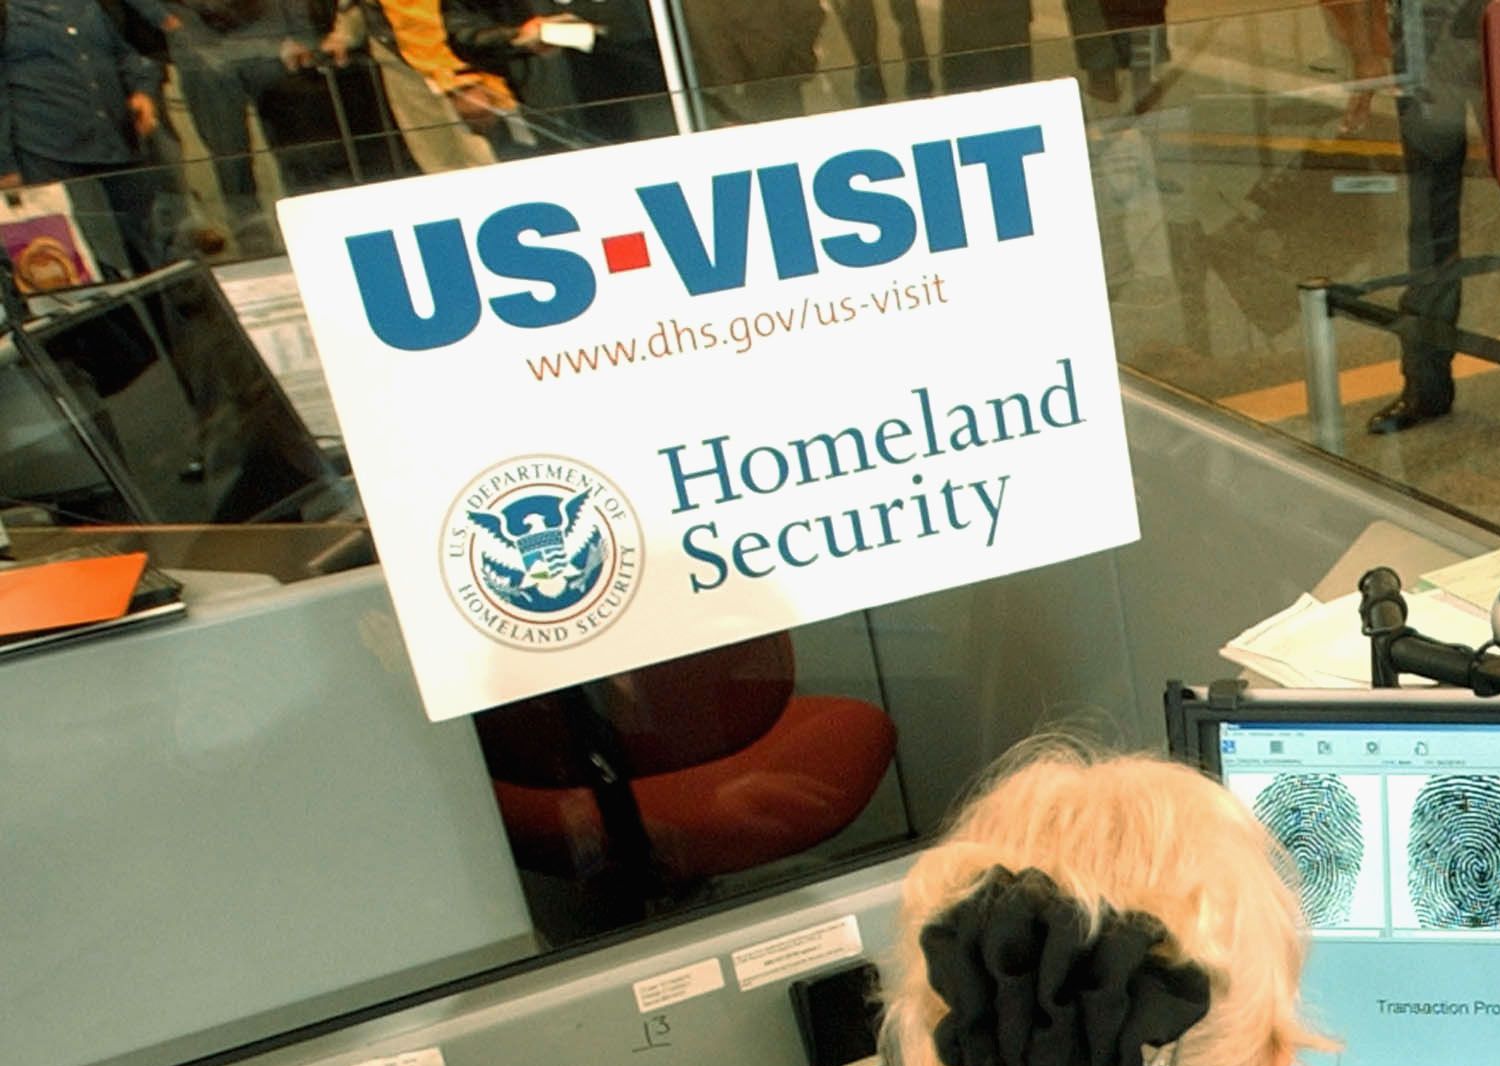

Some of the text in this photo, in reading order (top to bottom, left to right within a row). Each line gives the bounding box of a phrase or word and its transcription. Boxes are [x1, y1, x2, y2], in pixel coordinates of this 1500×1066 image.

[526, 274, 949, 381] www.dhs.gov/us-visit
[658, 358, 1087, 515] Homeland
[449, 463, 628, 558] U.S. DEPARTMENT OF
[681, 473, 1011, 594] Security
[457, 544, 636, 644] HOMELAND SECURITY
[643, 1015, 671, 1048] 13
[1377, 999, 1469, 1015] Transaction
